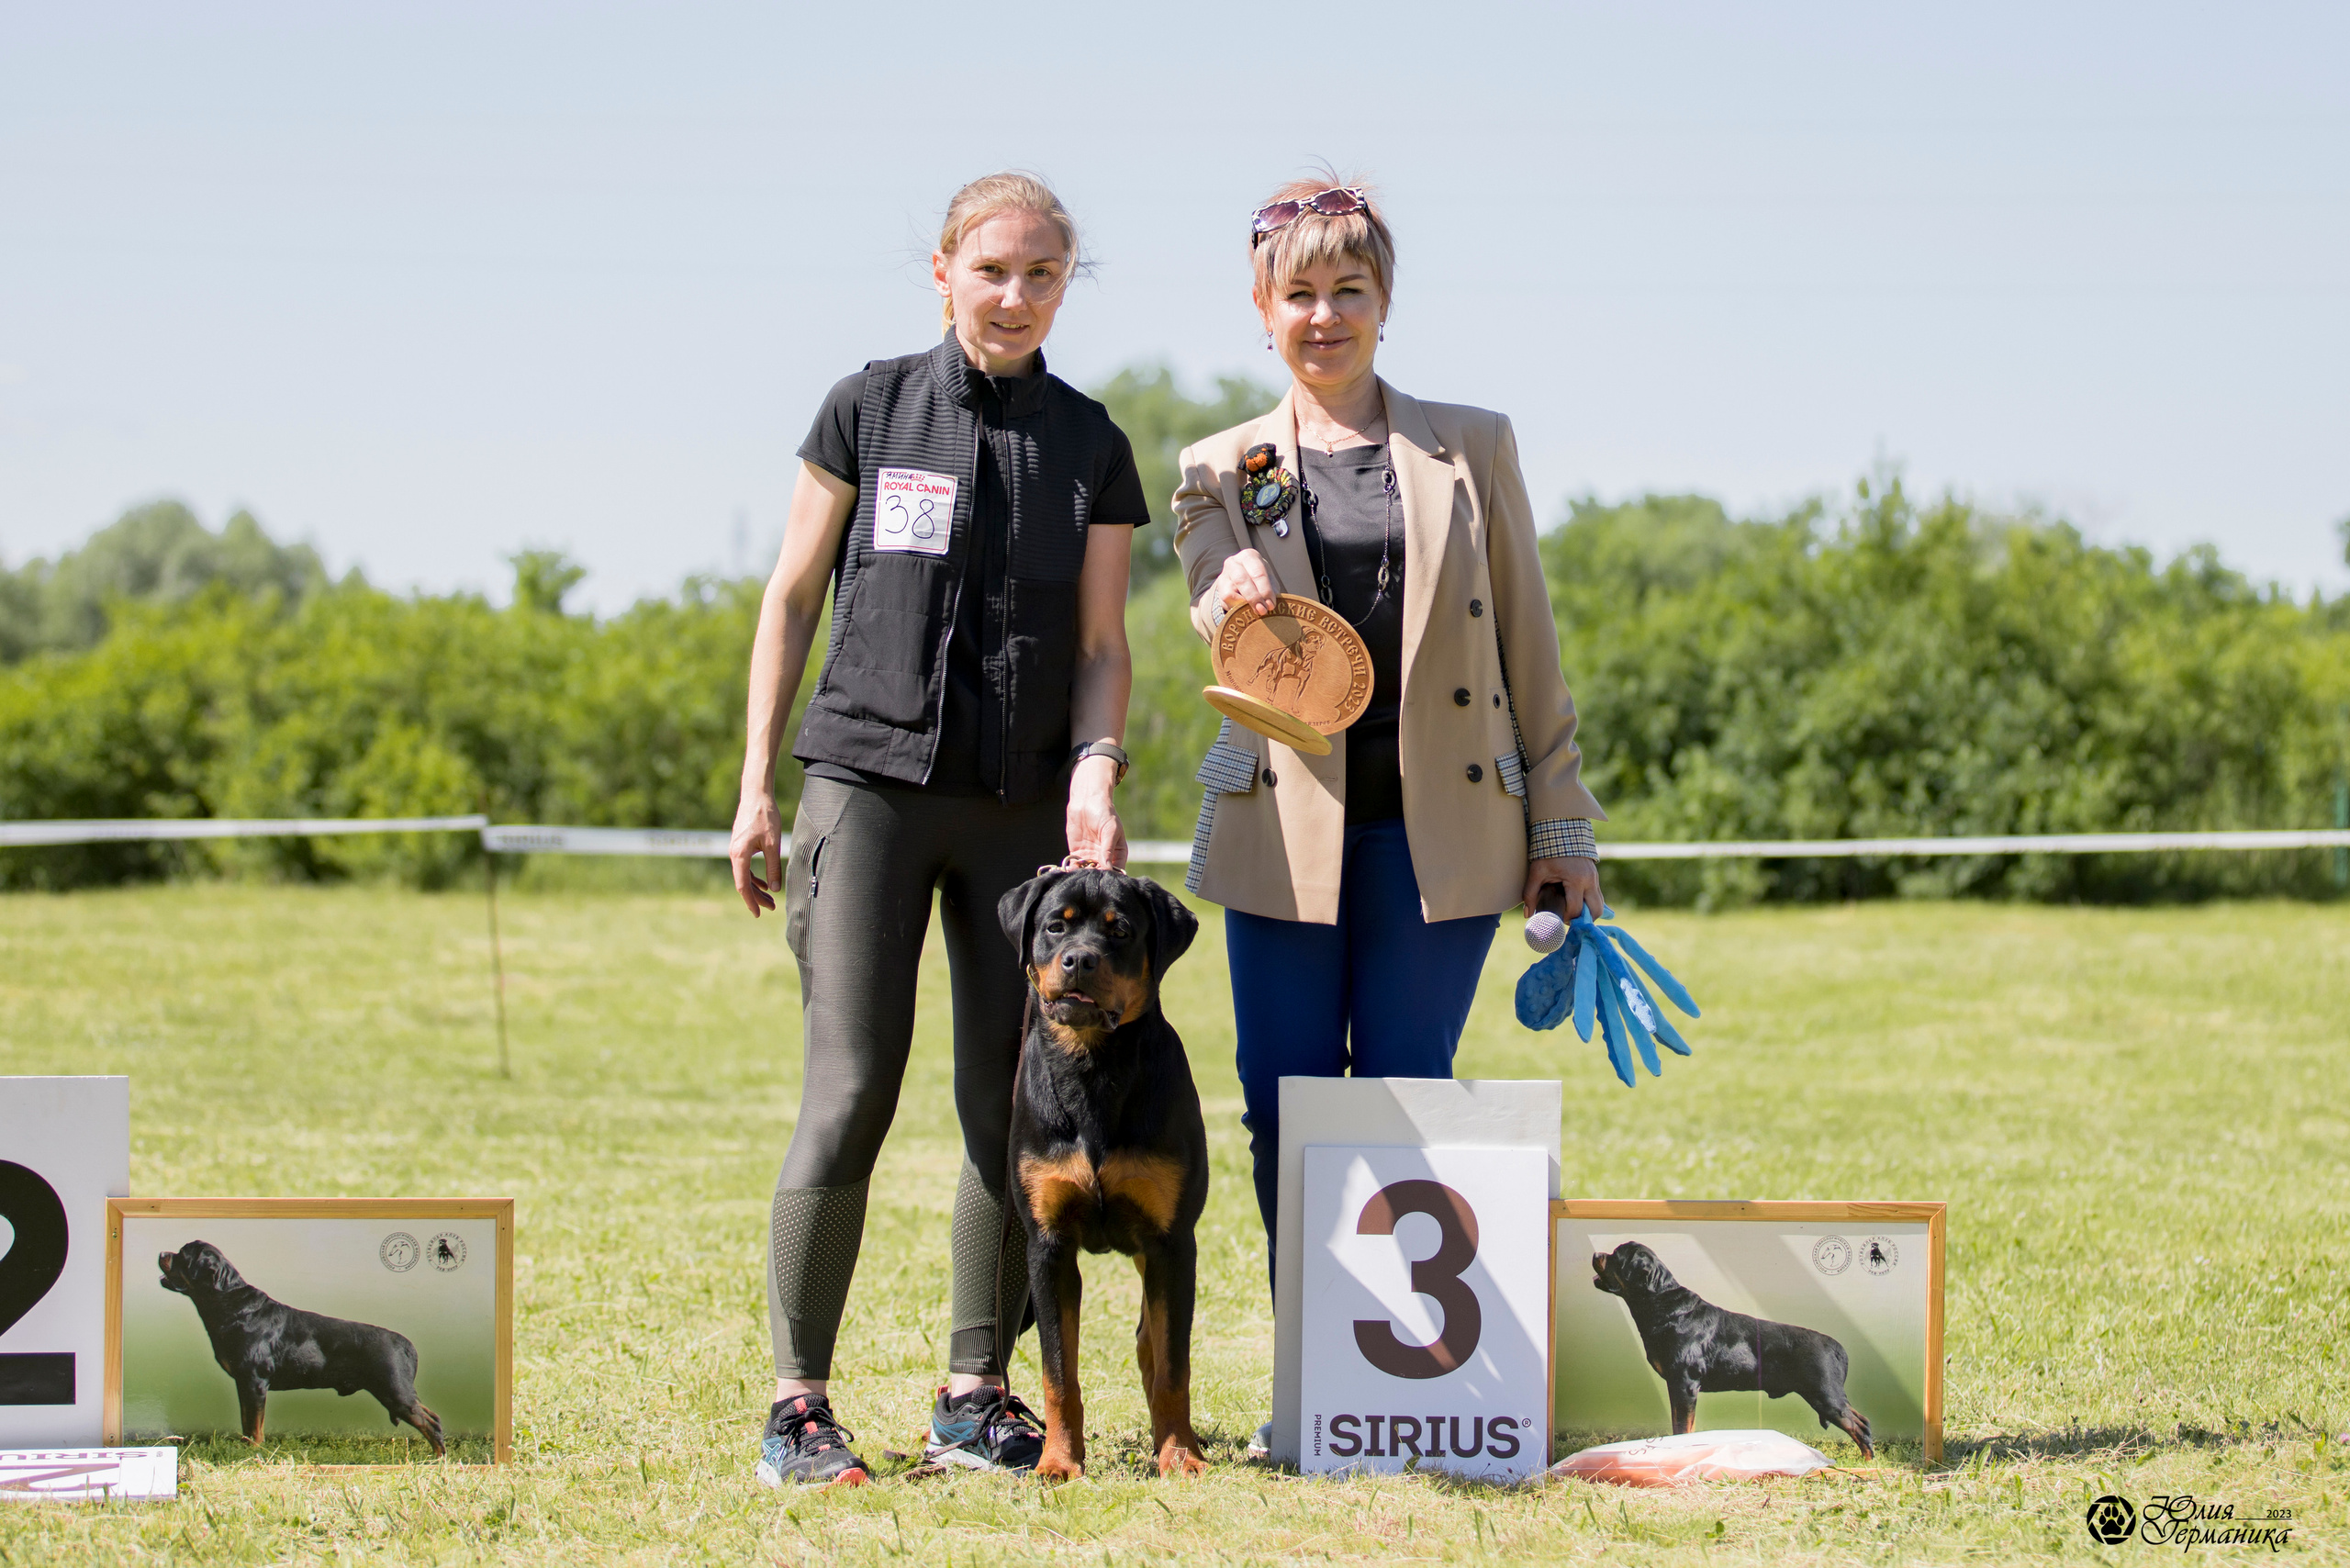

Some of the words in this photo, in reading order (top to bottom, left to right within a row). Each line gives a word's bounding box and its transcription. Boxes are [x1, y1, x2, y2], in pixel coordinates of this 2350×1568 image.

[884, 481, 914, 492] ROYAL
[916, 483, 950, 496] CANIN
[885, 495, 935, 540] 38
[1344, 682, 1367, 713] 2023
[1352, 1179, 1482, 1380] 3
[1314, 1414, 1322, 1457] PREMIUM
